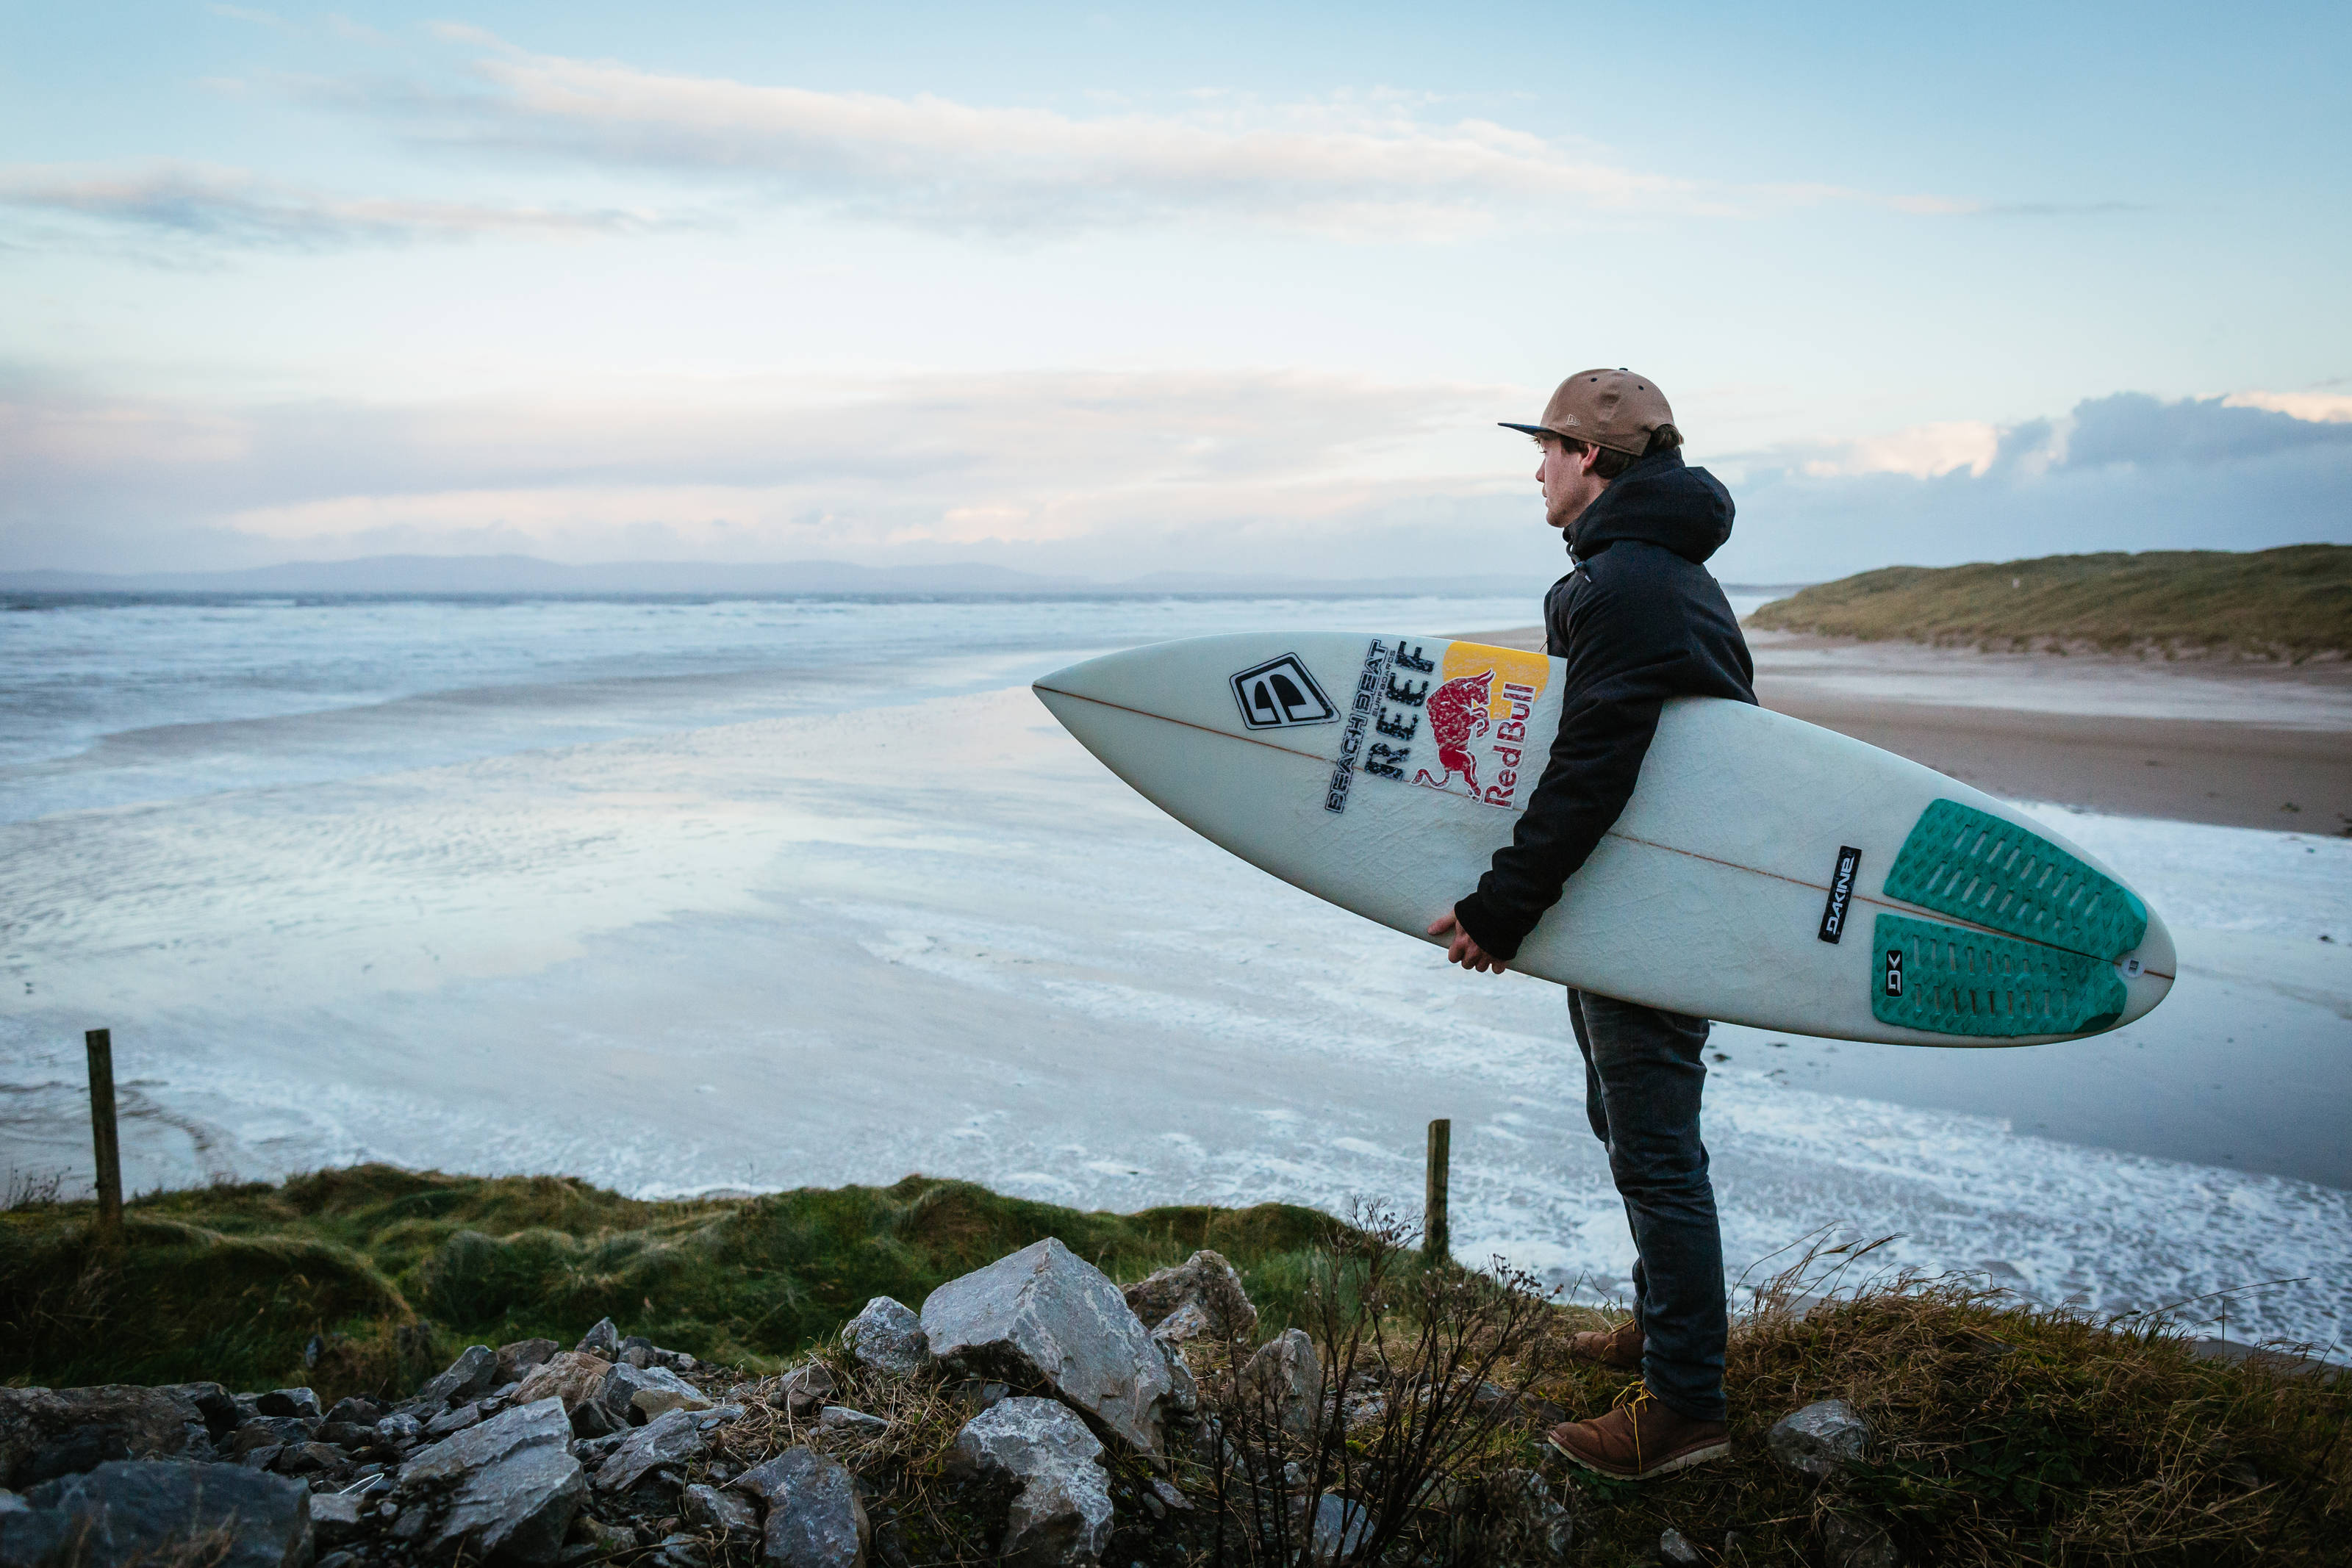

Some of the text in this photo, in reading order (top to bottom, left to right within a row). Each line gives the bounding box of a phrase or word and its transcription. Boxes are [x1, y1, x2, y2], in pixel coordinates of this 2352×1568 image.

[1325, 639, 1388, 814] BEACH BEAT
[1364, 640, 1435, 782] REEF
[1484, 683, 1536, 808] Red Bull
